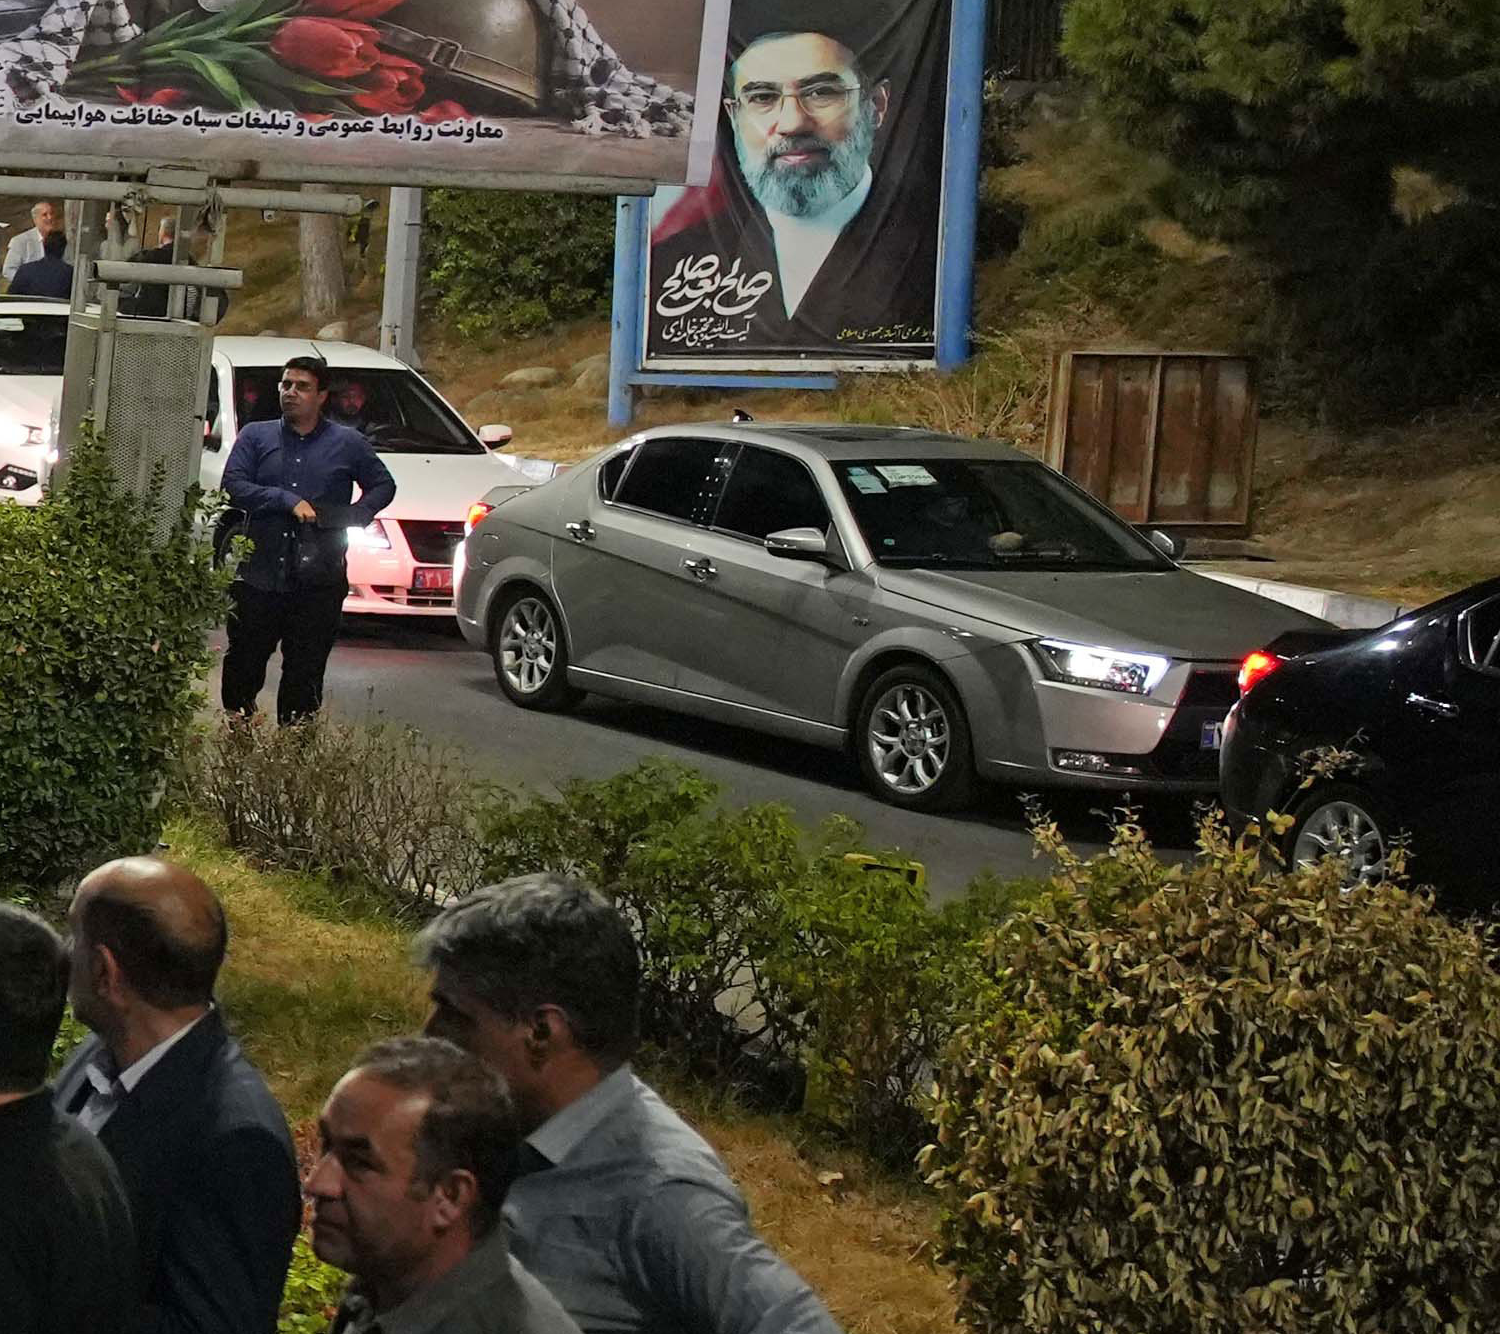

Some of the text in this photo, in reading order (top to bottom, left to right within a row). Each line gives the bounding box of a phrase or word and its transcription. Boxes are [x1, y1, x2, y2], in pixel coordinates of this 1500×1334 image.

[15, 102, 503, 142] معاونت روابط عمومی و تبلیغات سپاه حفاظت هواپیمایی
[656, 254, 773, 317] صالح بعد صالح
